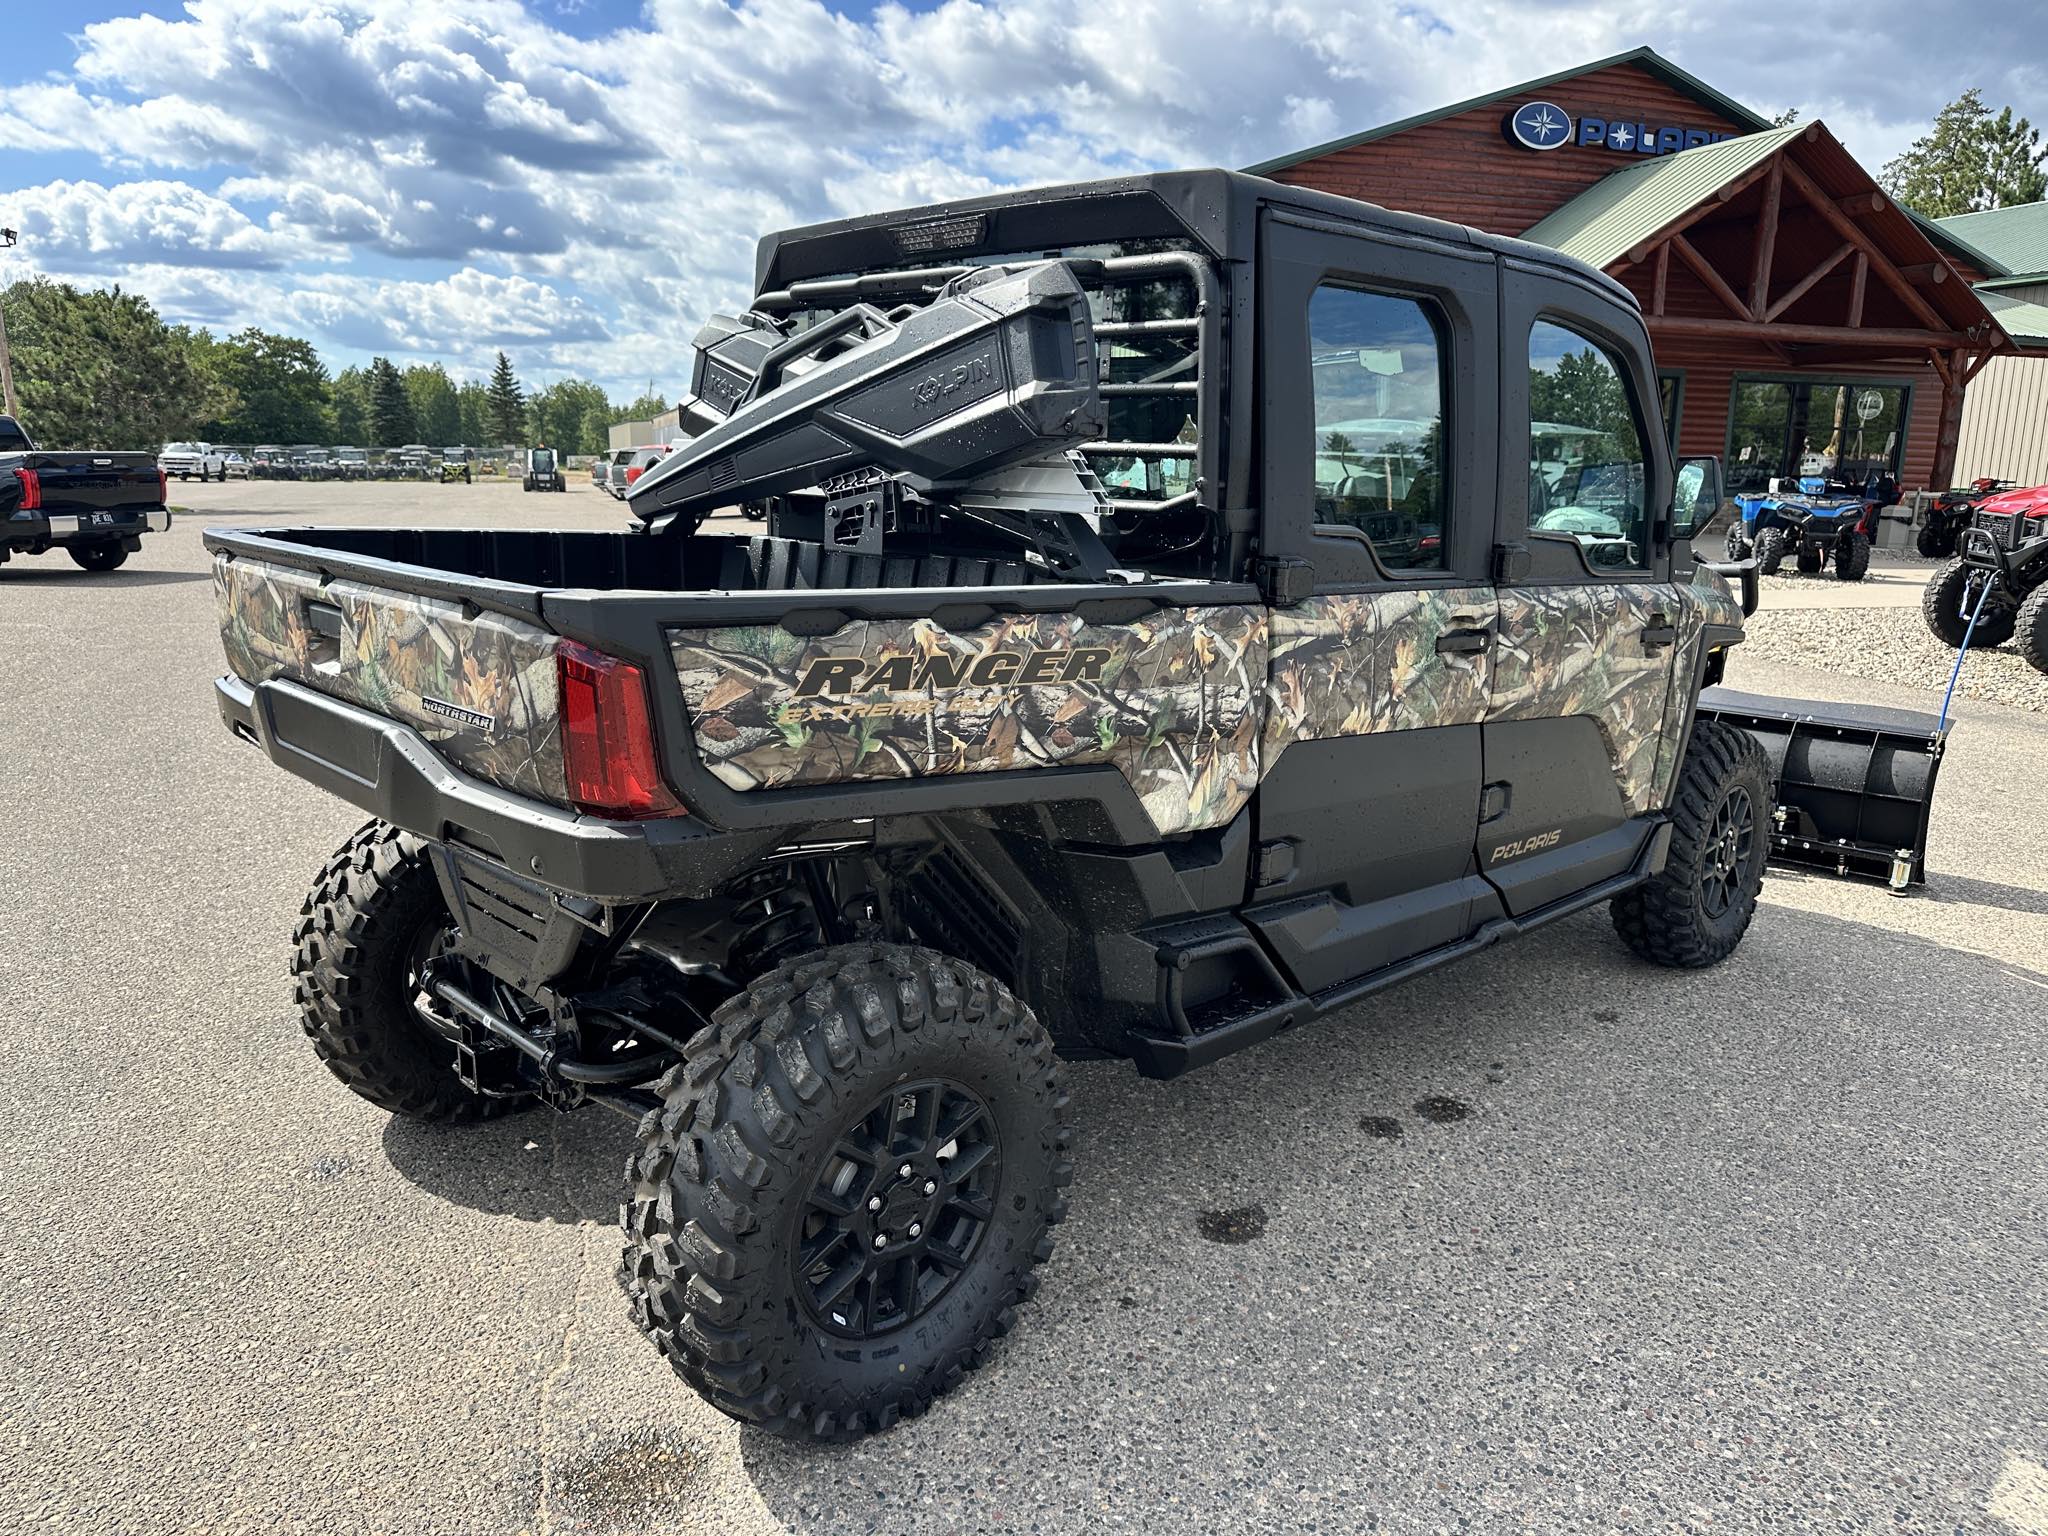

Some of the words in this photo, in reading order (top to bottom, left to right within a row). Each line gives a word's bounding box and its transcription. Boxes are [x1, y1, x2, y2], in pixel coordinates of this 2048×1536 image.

[1577, 117, 1739, 155] POLAR
[711, 374, 744, 401] KOL
[909, 353, 993, 406] KOLPIN
[794, 648, 1112, 700] RANGER
[423, 701, 490, 728] NORTHSTAR
[1490, 829, 1562, 863] POLARIS
